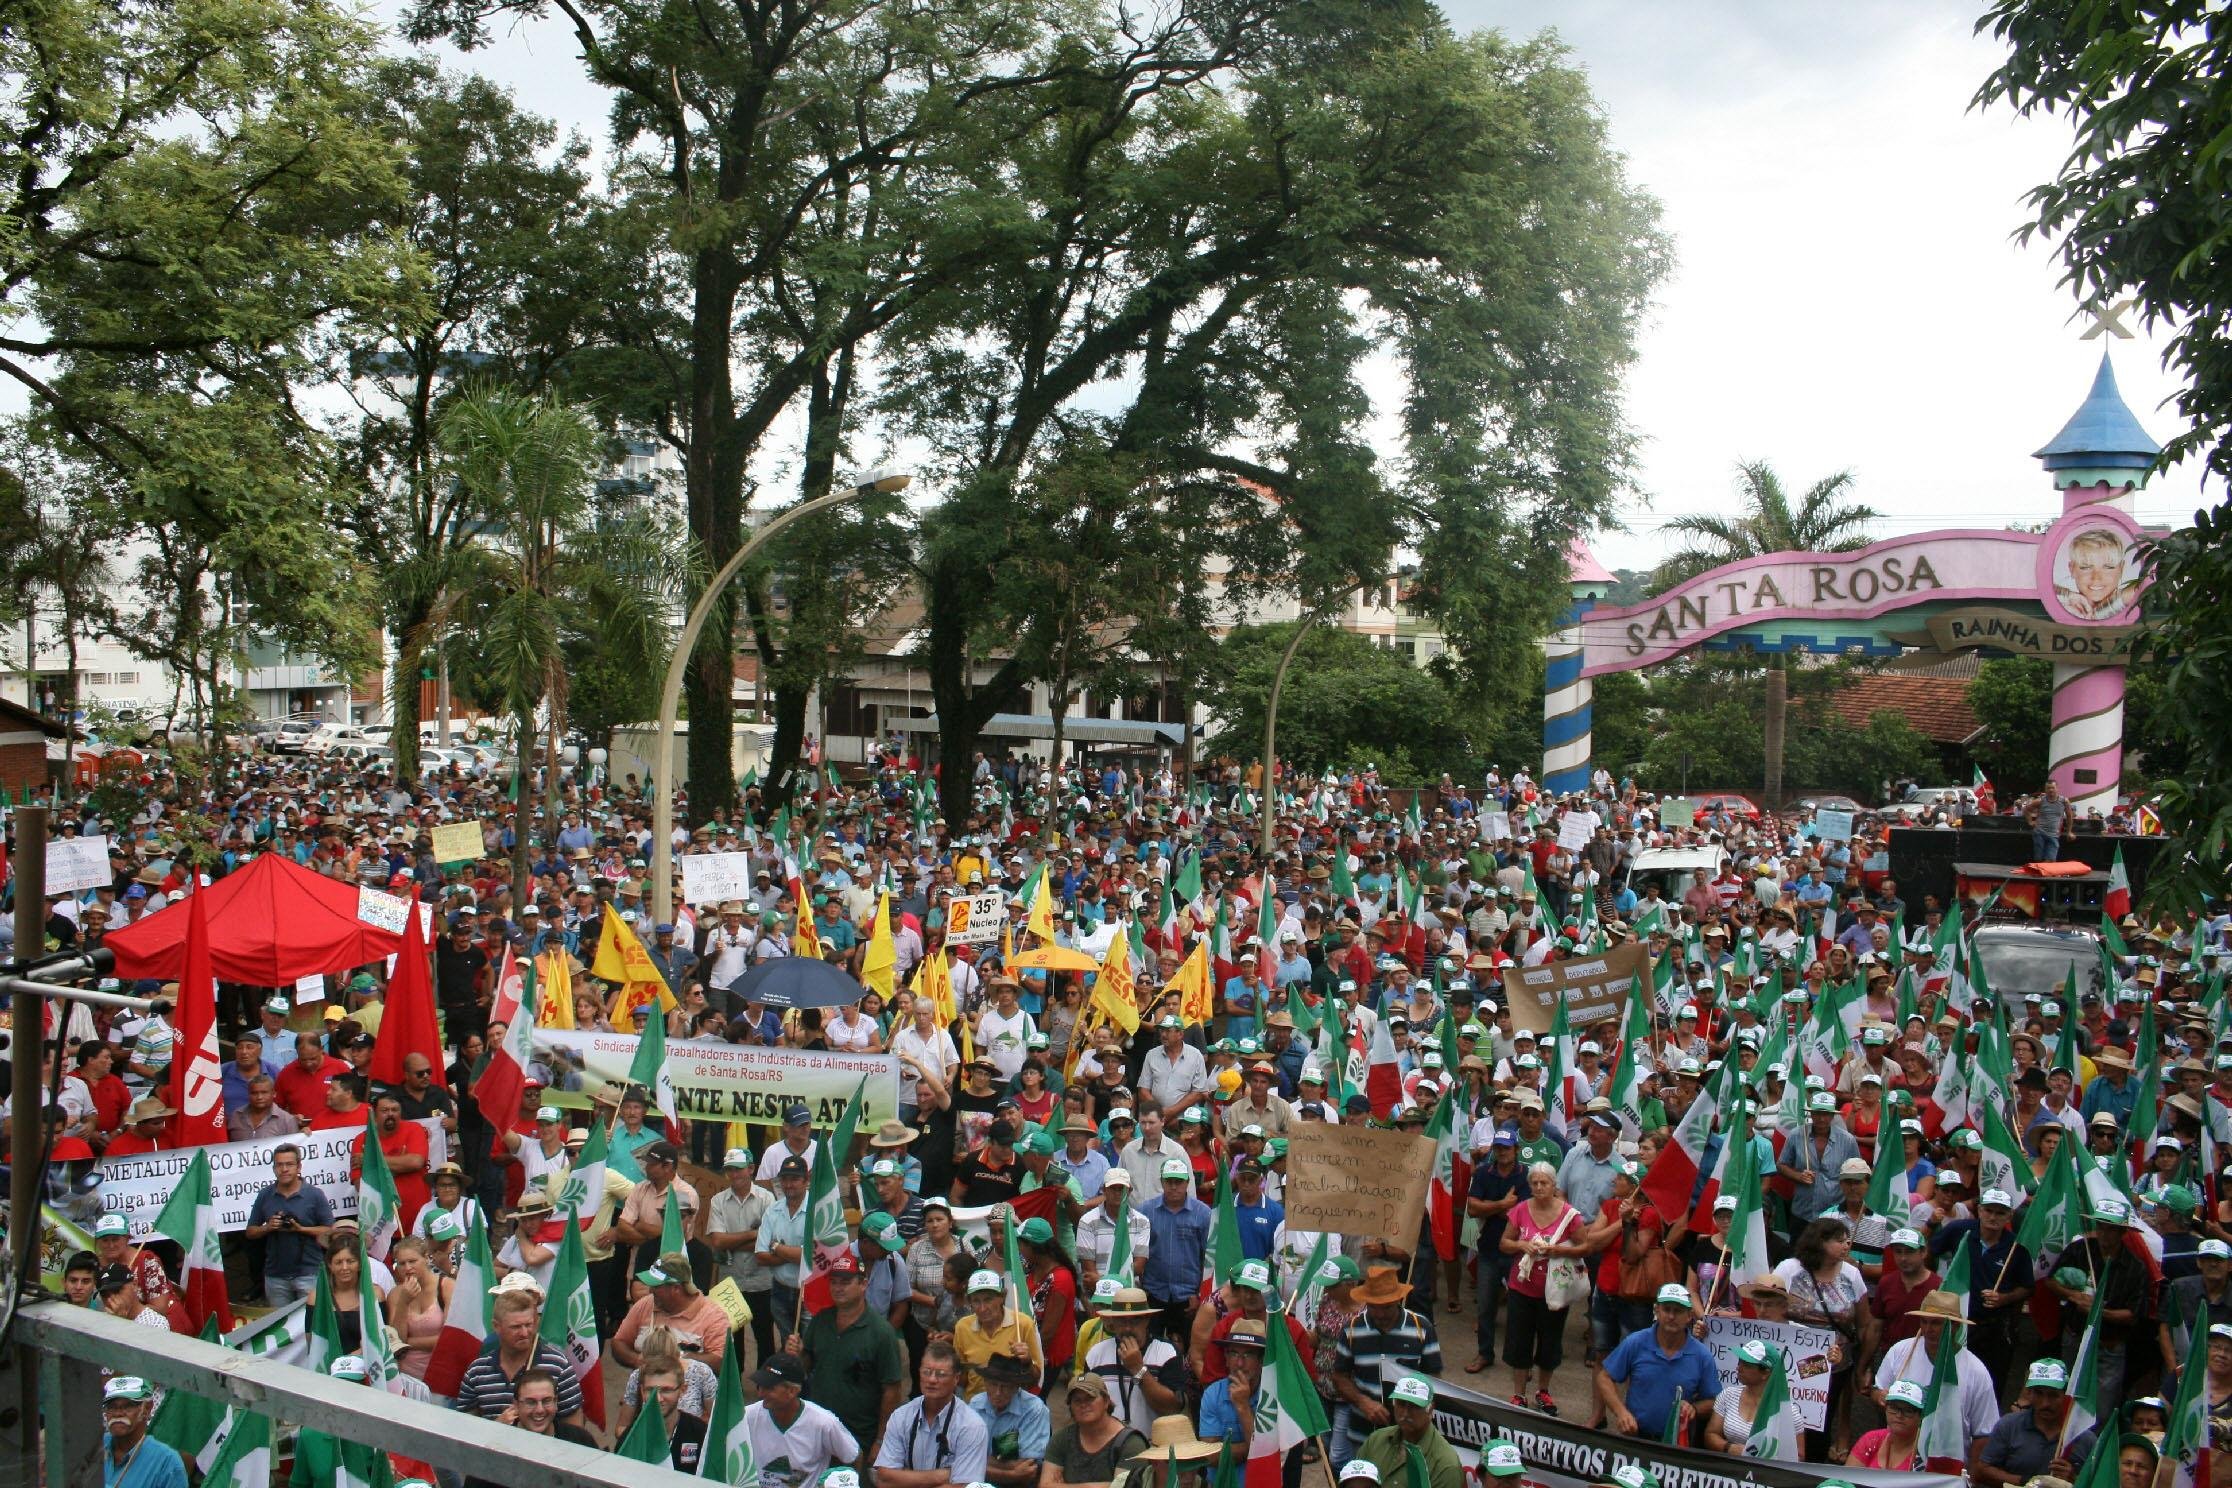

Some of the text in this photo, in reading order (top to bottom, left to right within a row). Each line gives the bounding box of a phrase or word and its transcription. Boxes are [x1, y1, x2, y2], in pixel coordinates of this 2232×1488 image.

[1626, 555, 1943, 657] SANTA ROSA
[1952, 618, 2041, 650] RAINHA
[2052, 634, 2103, 654] DOS
[665, 1044, 735, 1061] Trabalhadores
[738, 1052, 755, 1063] nas
[758, 1051, 807, 1068] Indústrias
[810, 1057, 822, 1068] da
[825, 1057, 887, 1076] Alimentação
[695, 1064, 783, 1082] de Santa Rosa/RS
[816, 1096, 870, 1127] AT!
[104, 1153, 233, 1182] METALÚRCO
[239, 1145, 274, 1168] NÃO
[105, 1193, 145, 1213] Diga
[1710, 1319, 1830, 1351] O BRASIL ESTÁ
